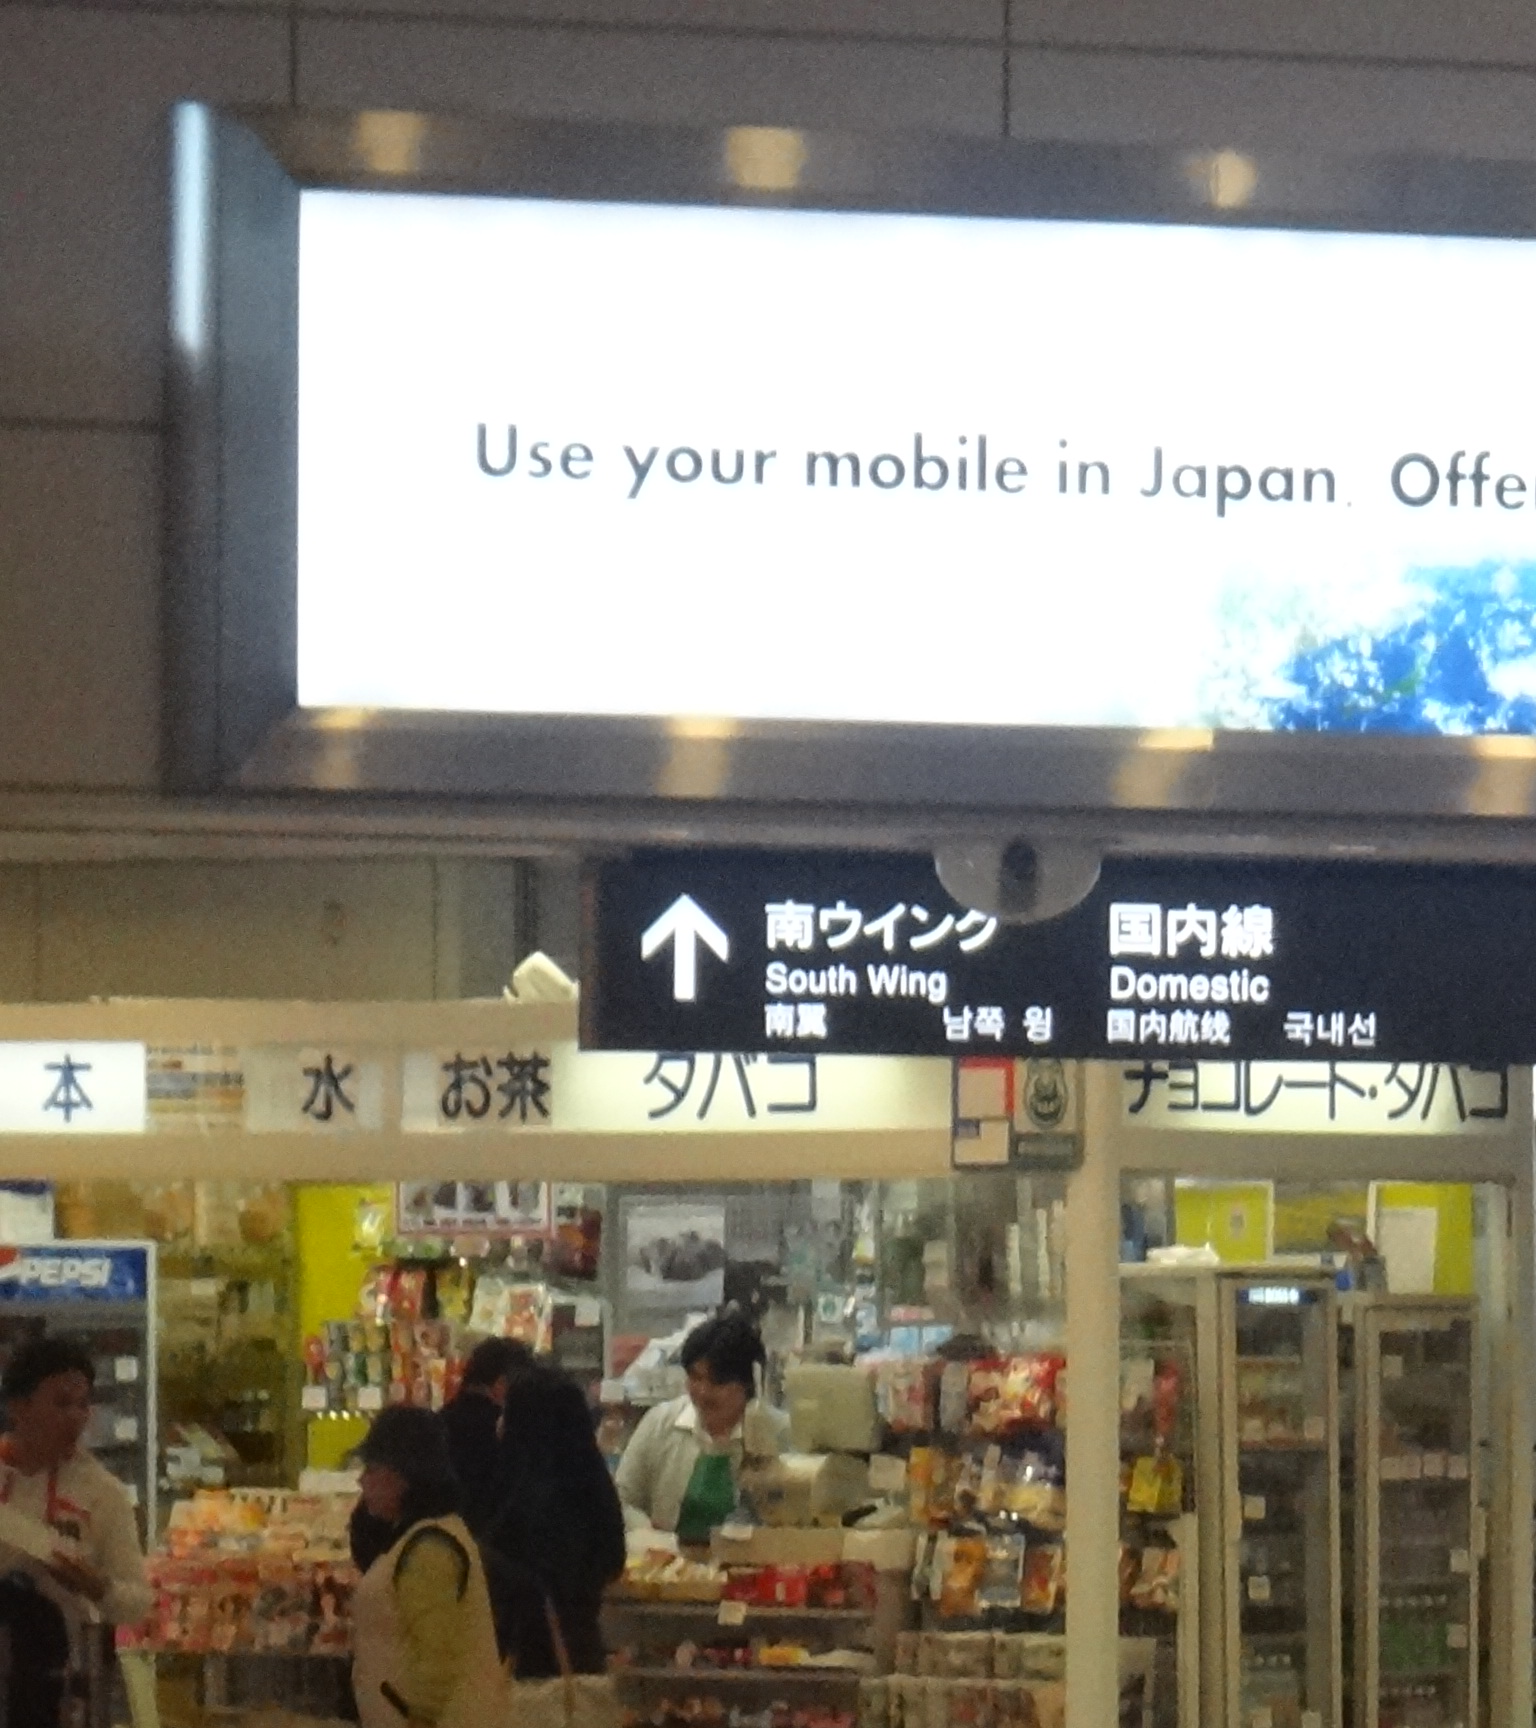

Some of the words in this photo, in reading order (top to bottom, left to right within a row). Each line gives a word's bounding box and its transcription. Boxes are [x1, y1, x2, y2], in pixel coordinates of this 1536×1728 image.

[476, 422, 594, 480] Use
[622, 445, 778, 499] your
[805, 431, 1029, 494] mobile
[1058, 438, 1110, 495] in
[1109, 903, 1274, 958] 国内線
[765, 961, 857, 995] South
[867, 964, 948, 1006] Wing
[1110, 966, 1270, 1003] Domestic
[1107, 1009, 1232, 1045] 国内航线
[1284, 1010, 1376, 1047] 국내선
[43, 1054, 93, 1123] 本
[302, 1054, 355, 1121] 水
[440, 1053, 552, 1123] お茶
[643, 1053, 817, 1120] タバコ
[20, 1256, 111, 1288] PEPSI
